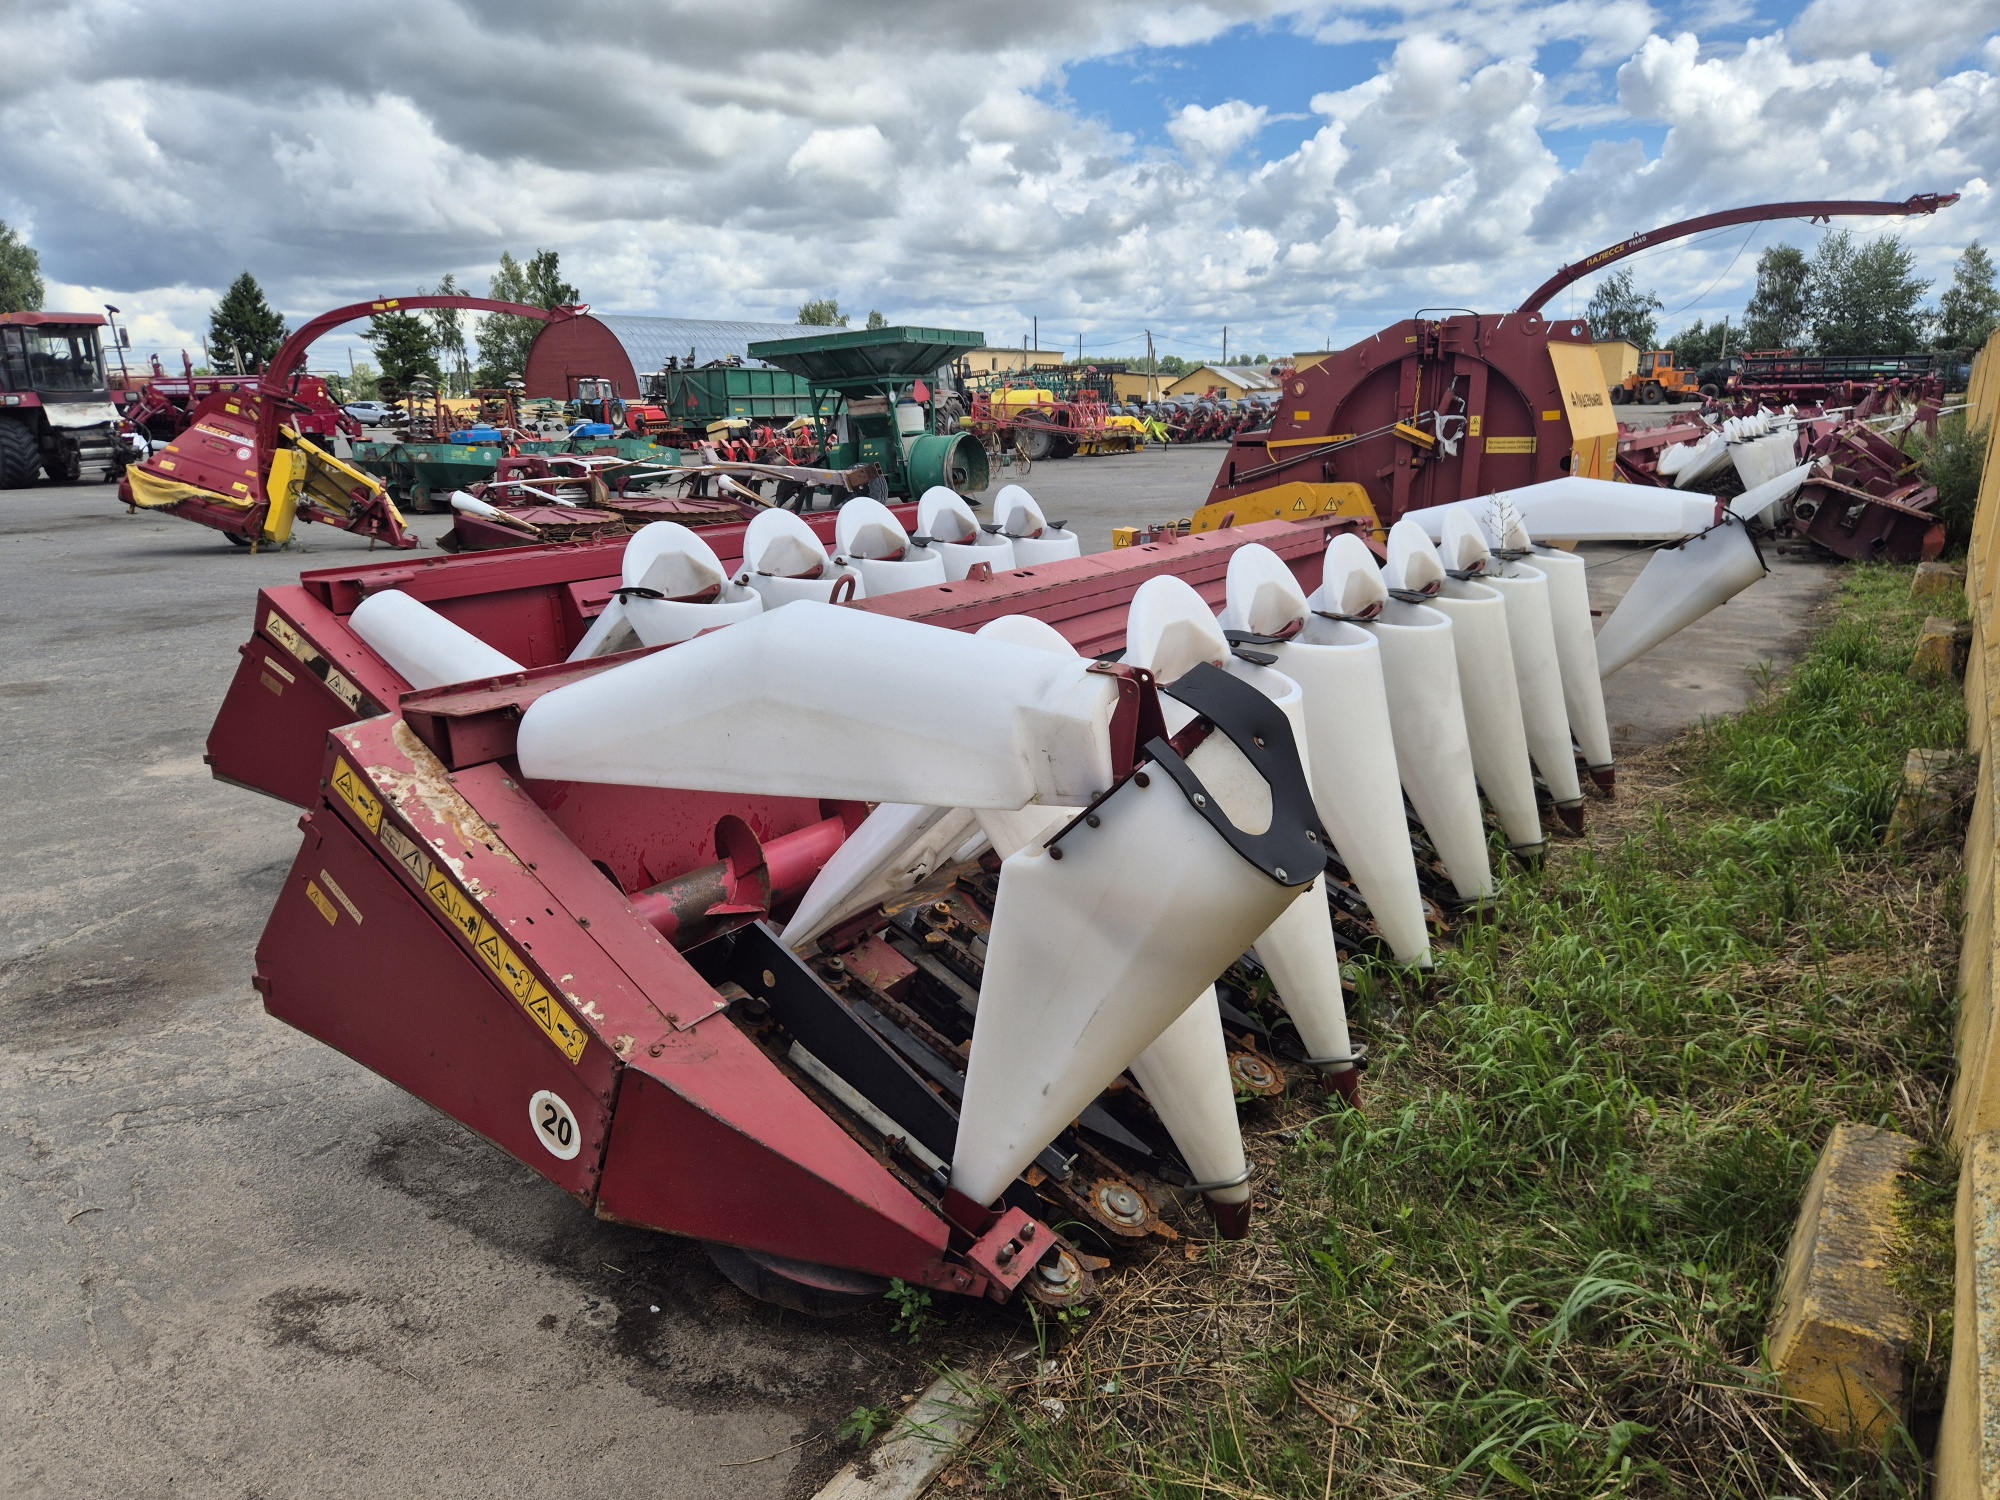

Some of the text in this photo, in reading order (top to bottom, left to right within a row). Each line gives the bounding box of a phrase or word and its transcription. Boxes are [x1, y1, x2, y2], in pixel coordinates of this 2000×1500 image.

[1586, 235, 1647, 267] ПАЛЕССЕ FH40
[541, 1103, 572, 1146] 20
